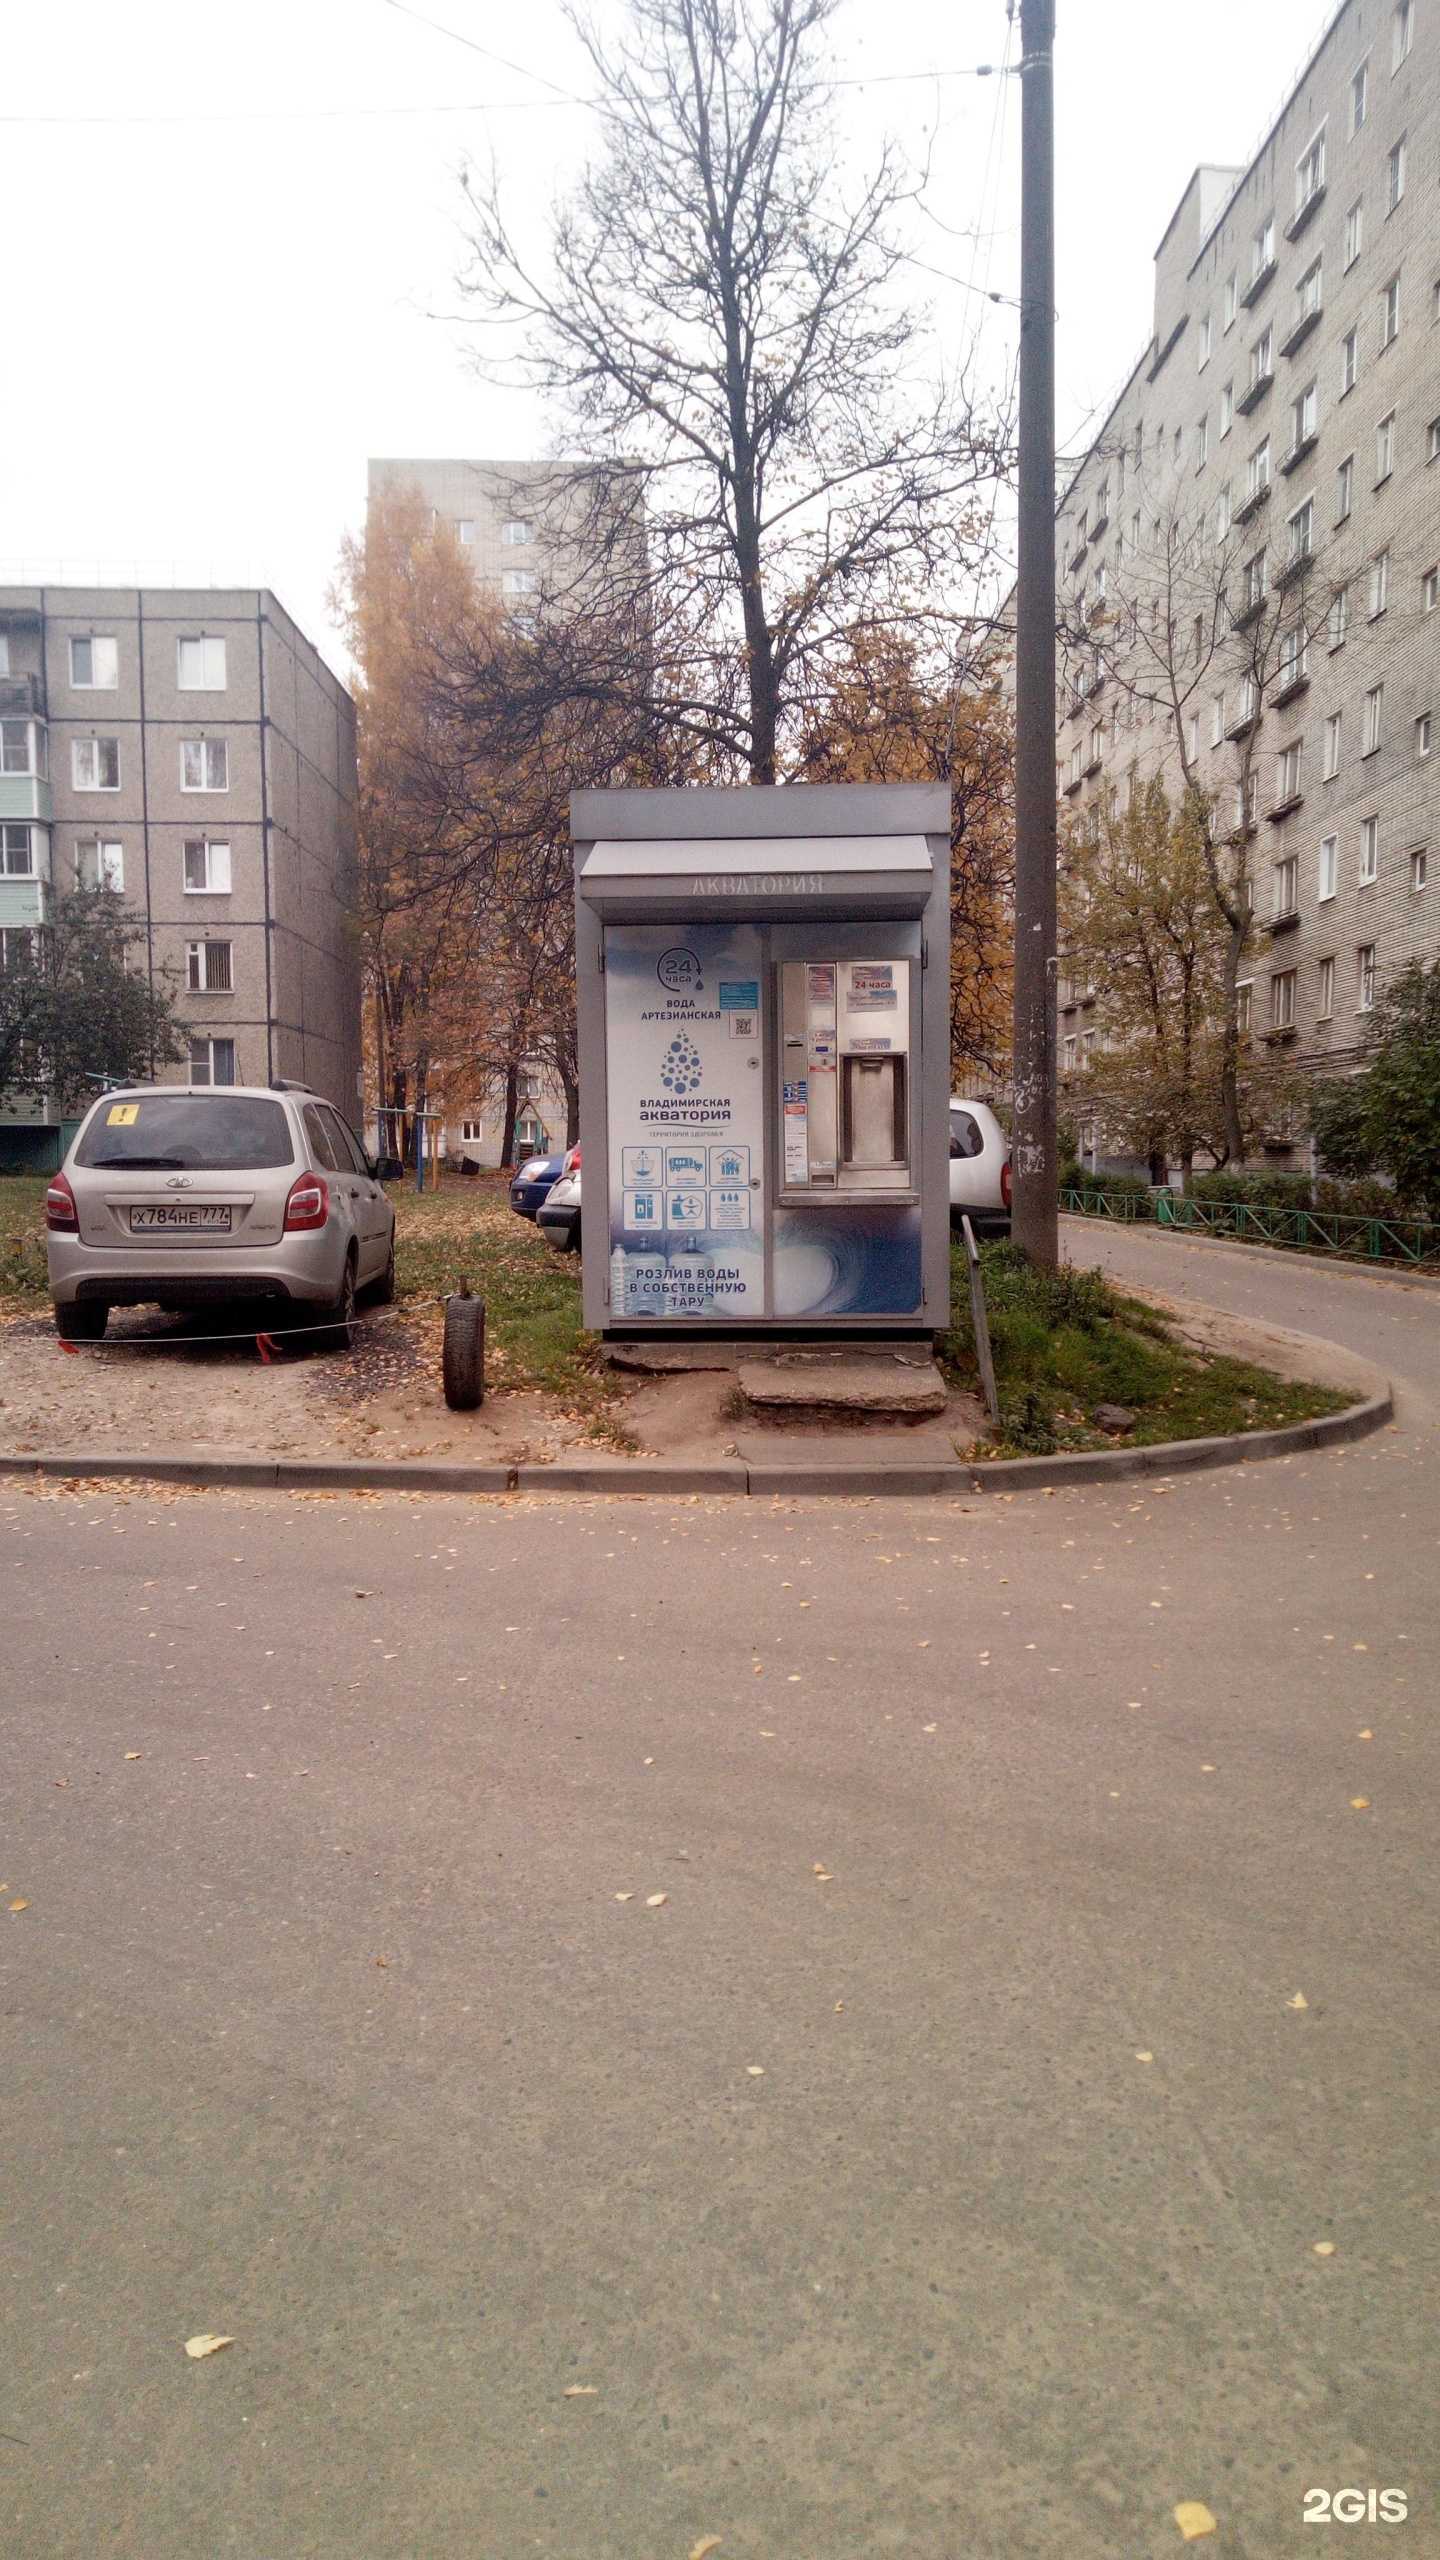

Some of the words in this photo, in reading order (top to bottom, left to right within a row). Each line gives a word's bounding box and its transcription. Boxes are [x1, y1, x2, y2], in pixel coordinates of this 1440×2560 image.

[692, 875, 822, 895] АКВАТОРИЯ
[665, 960, 692, 974] 24
[666, 1000, 696, 1009] ВОДА
[641, 1011, 721, 1020] АРТЕЗИАНСКАЯ
[640, 1099, 731, 1109] ВЛАДИМИРСКАЯ
[639, 1110, 731, 1122] акватория
[202, 1207, 226, 1219] 777
[636, 1269, 692, 1279] РОЗЛИВ
[697, 1269, 740, 1280] ВОДЫ
[630, 1283, 638, 1293] В
[643, 1283, 747, 1293] СОБСТВЕННУЮ
[672, 1297, 704, 1307] ТАРУ
